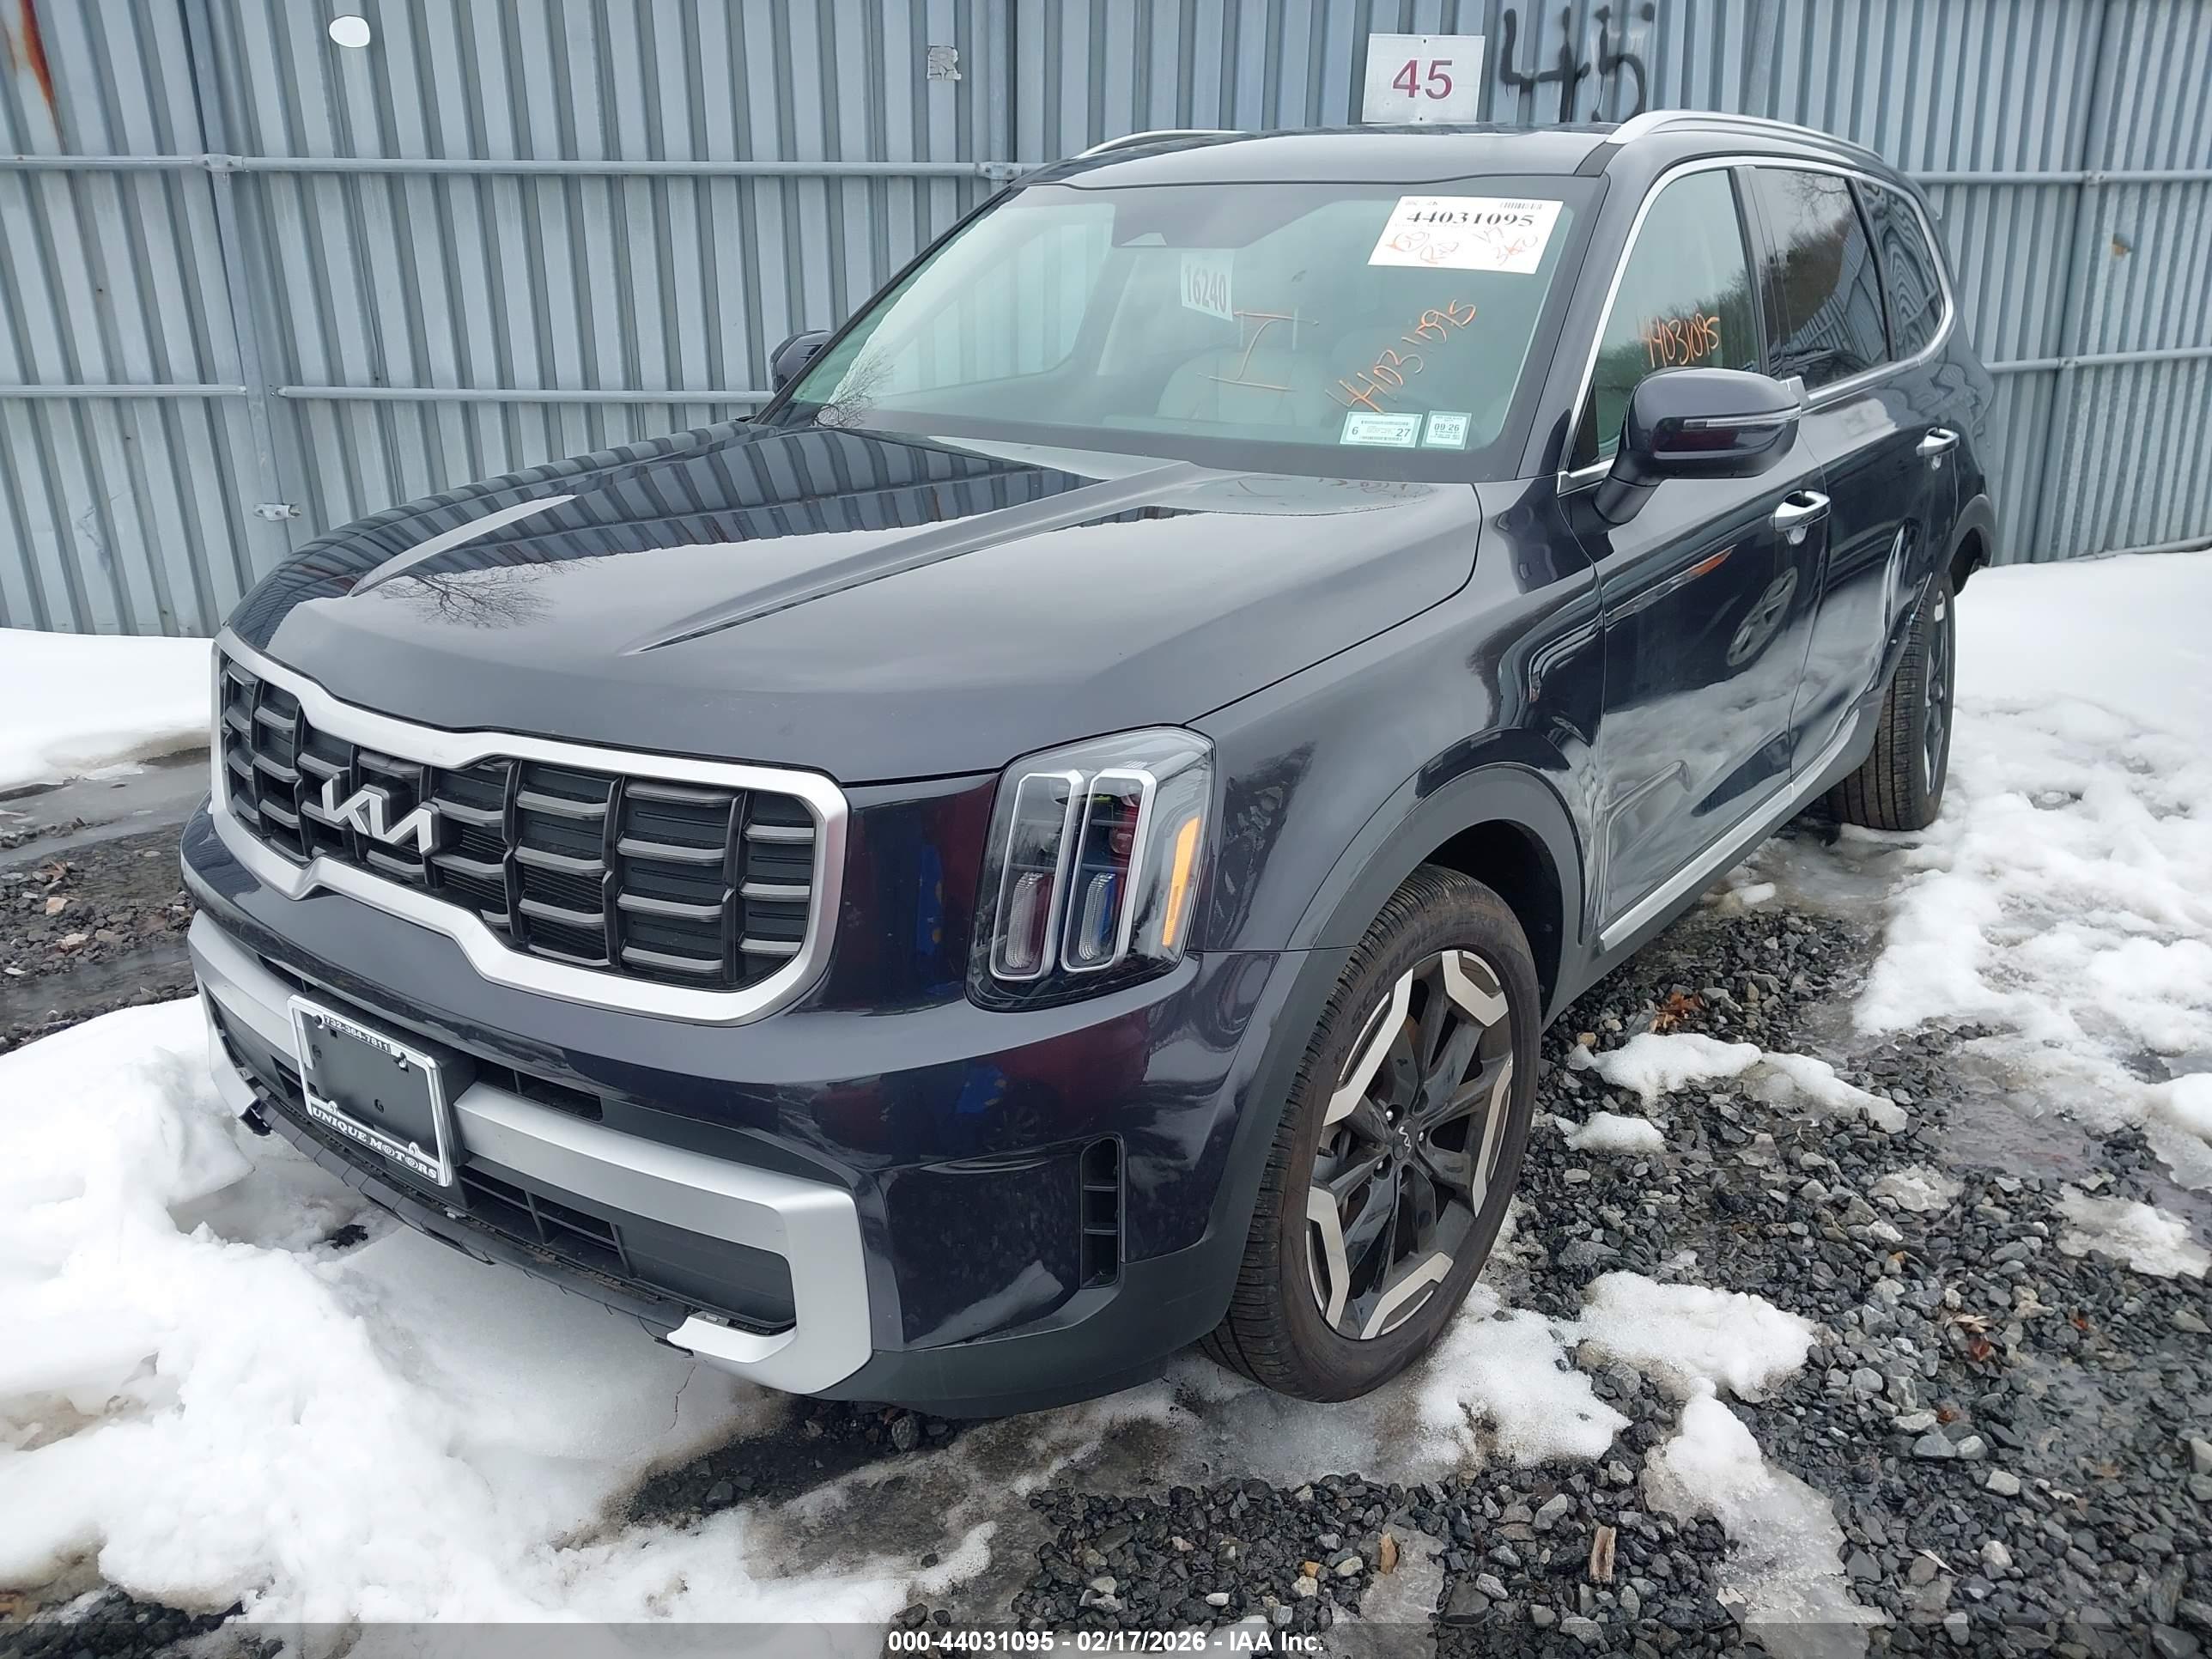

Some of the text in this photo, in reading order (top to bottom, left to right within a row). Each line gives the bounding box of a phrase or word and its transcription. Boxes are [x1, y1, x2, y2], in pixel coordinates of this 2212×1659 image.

[1391, 59, 1453, 100] 45
[1406, 210, 1534, 227] 44031095
[1185, 264, 1227, 313] 16240
[1352, 426, 1359, 435] 6
[1395, 428, 1411, 438] 27
[312, 1106, 438, 1179] UNIQUE MOTORS
